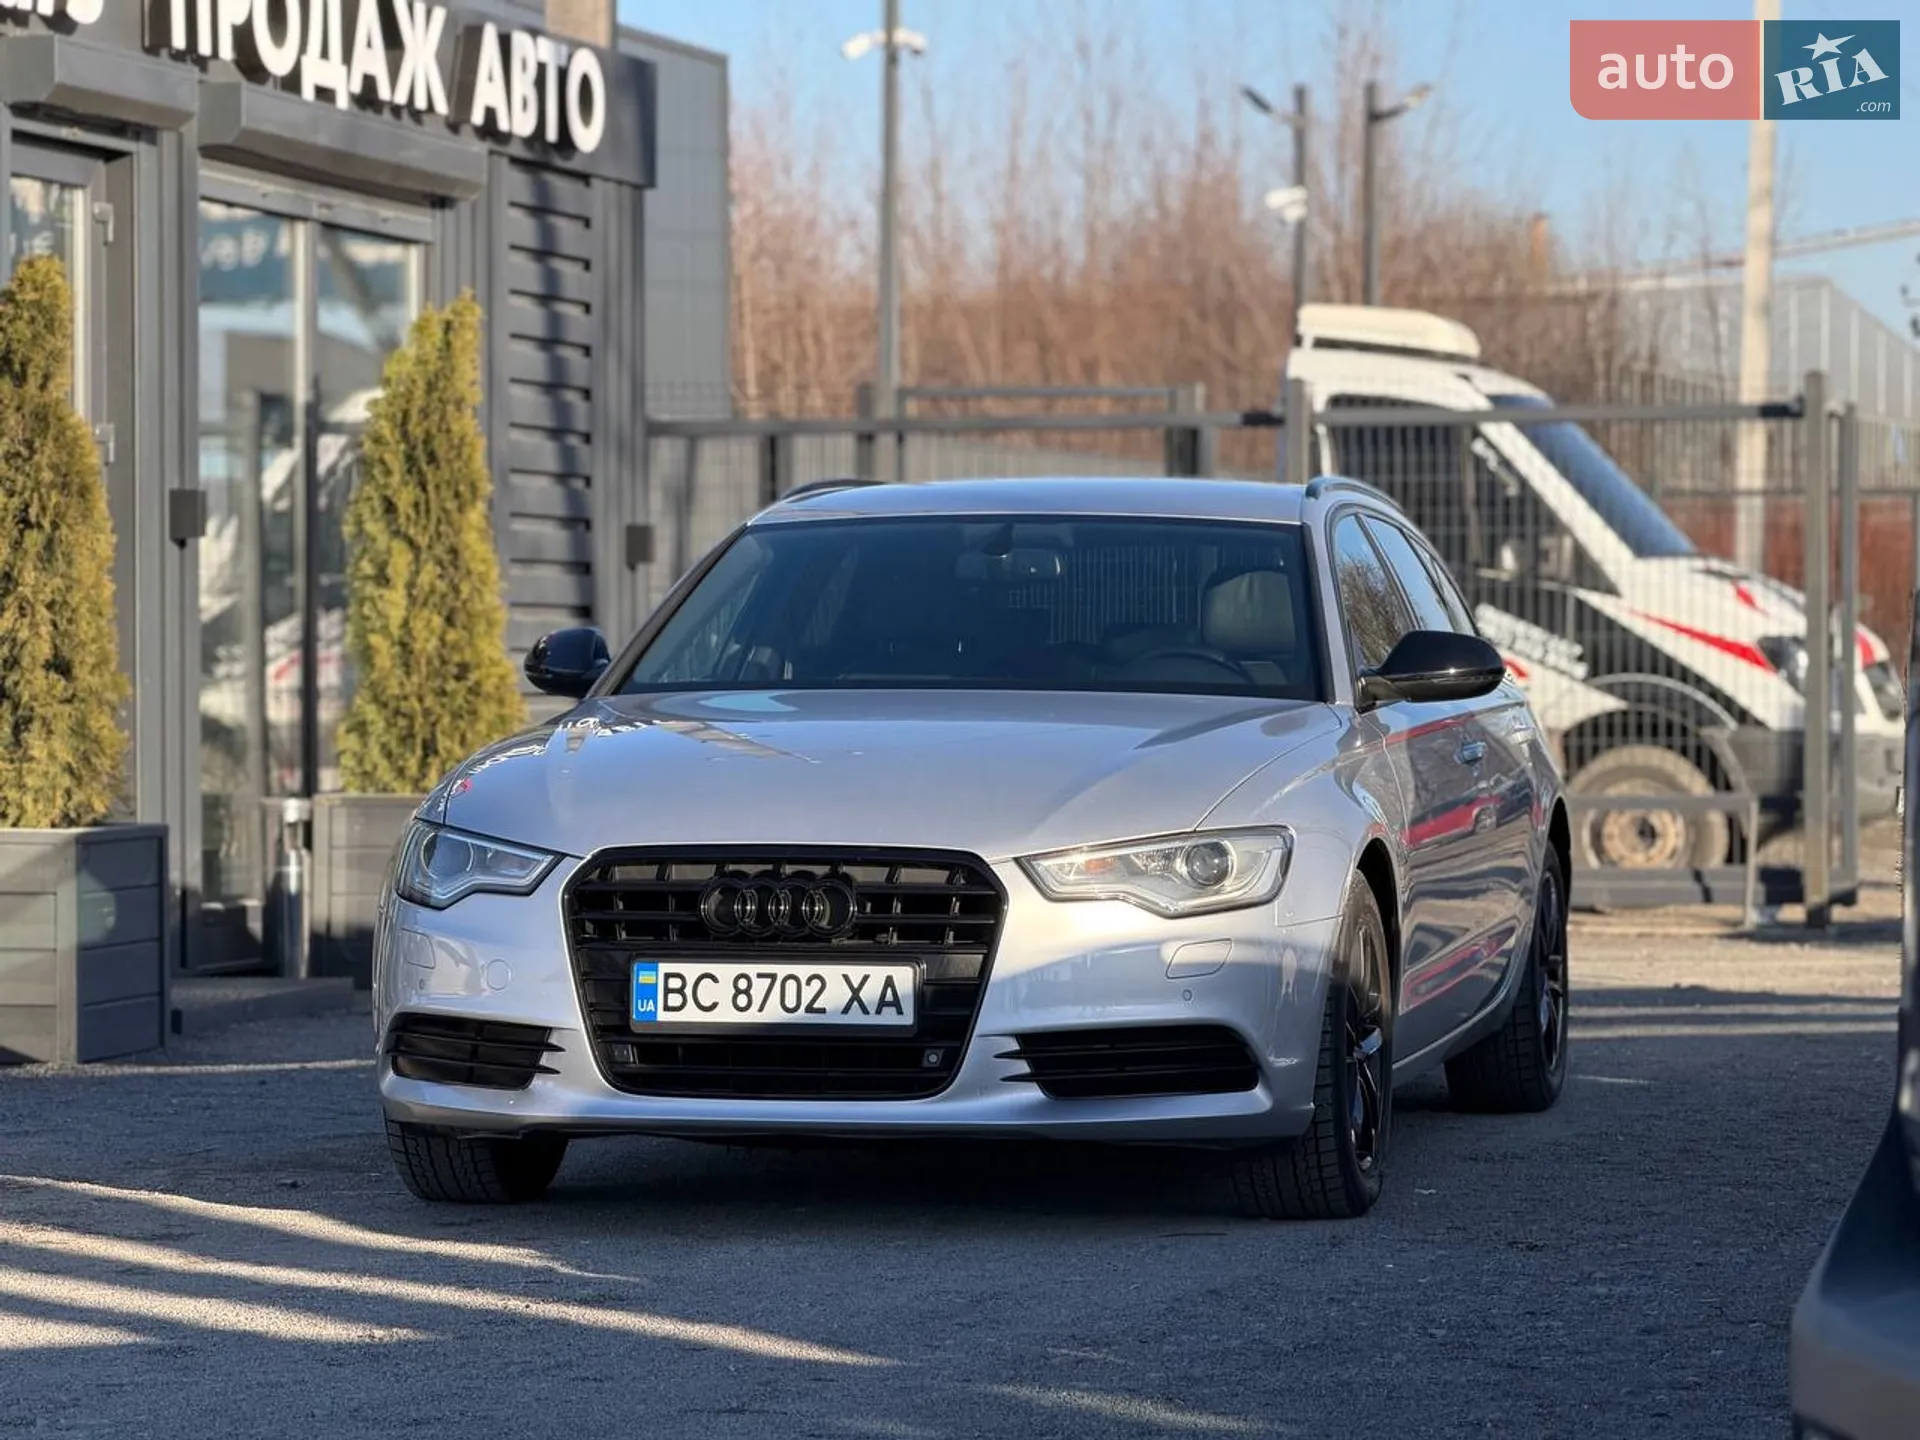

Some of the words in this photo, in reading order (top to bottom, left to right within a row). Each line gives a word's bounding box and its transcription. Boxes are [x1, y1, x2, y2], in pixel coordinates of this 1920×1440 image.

[471, 21, 606, 154] АВТО
[638, 998, 655, 1012] UA
[663, 972, 720, 1013] BC
[731, 973, 827, 1014] 8702
[841, 973, 904, 1016] XA
